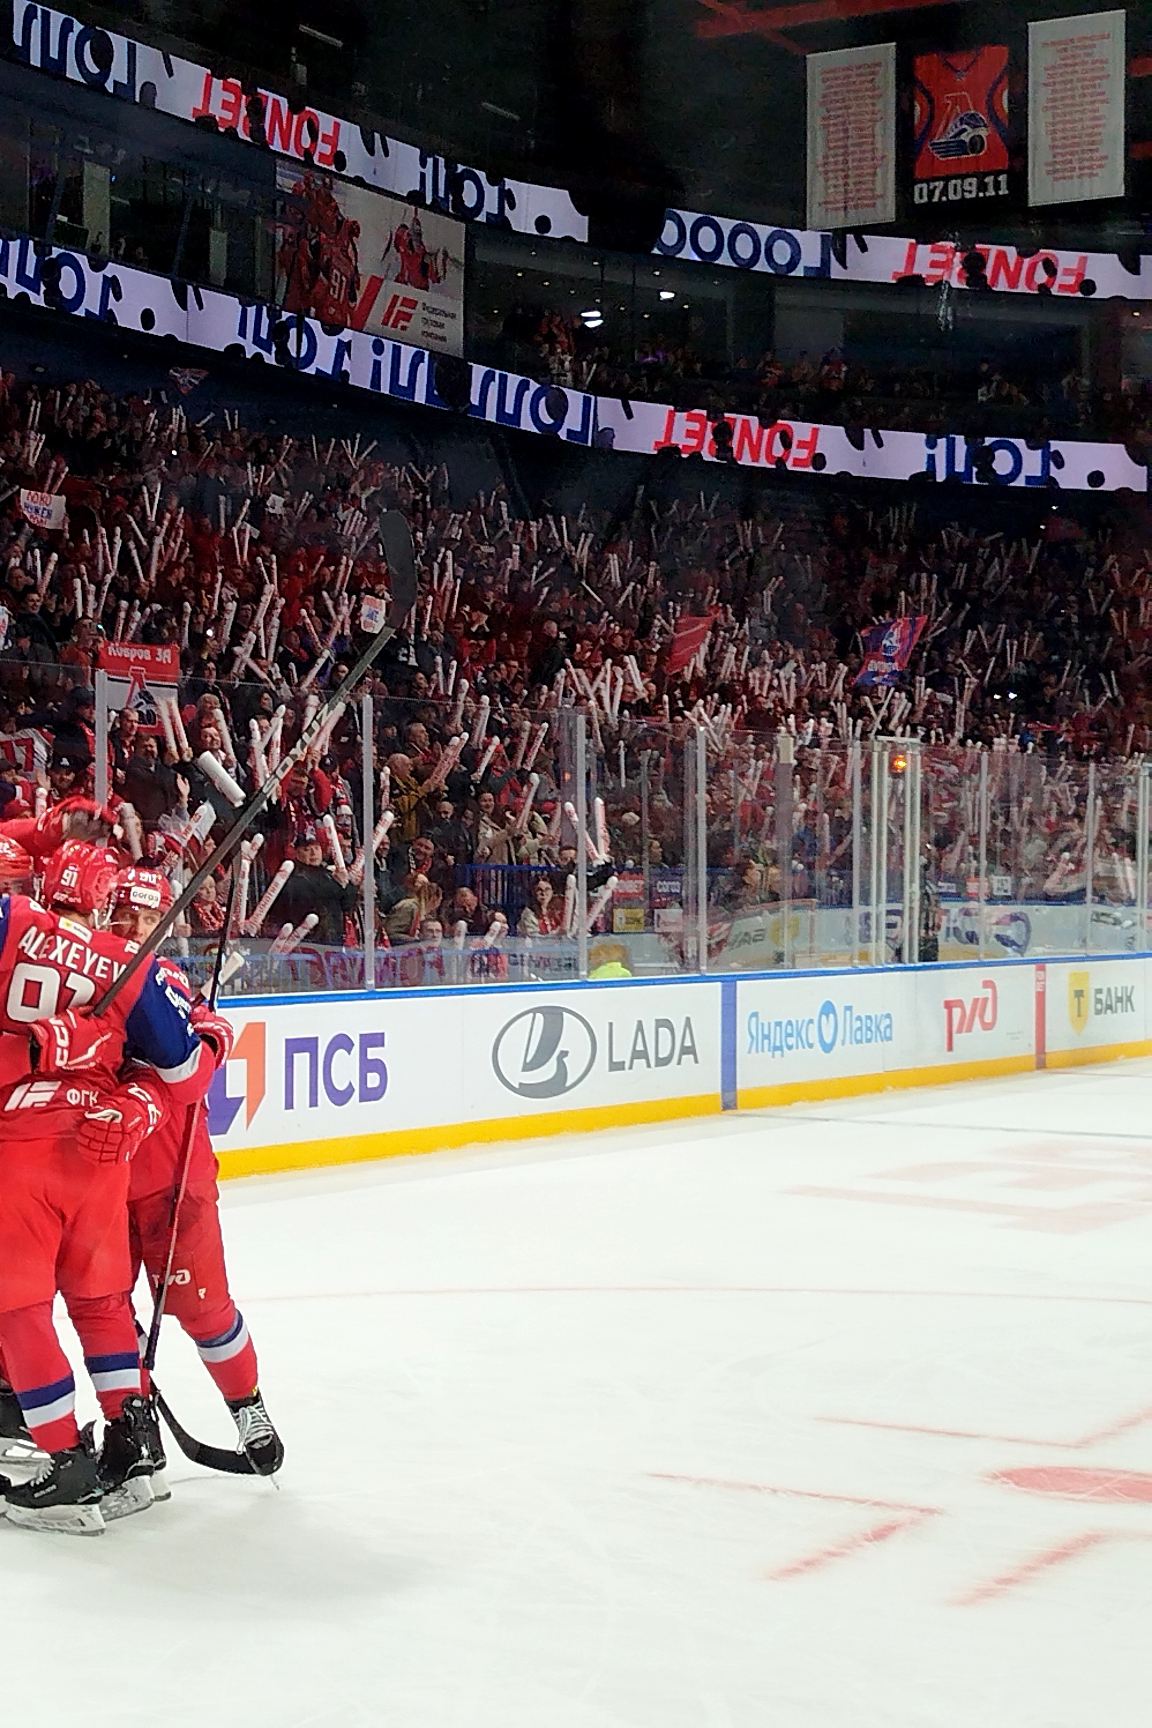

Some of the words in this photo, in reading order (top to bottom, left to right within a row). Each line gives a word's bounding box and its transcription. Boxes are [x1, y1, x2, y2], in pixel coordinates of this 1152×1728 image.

[913, 173, 1009, 204] 07.09.11
[61, 869, 78, 887] 91
[18, 926, 127, 983] ALEXEYEV
[1094, 985, 1135, 1016] БАНК
[608, 1016, 699, 1073] LADA
[747, 1010, 815, 1058] Яндекс
[841, 1002, 893, 1049] Лавка
[284, 1032, 388, 1110] ПСБ
